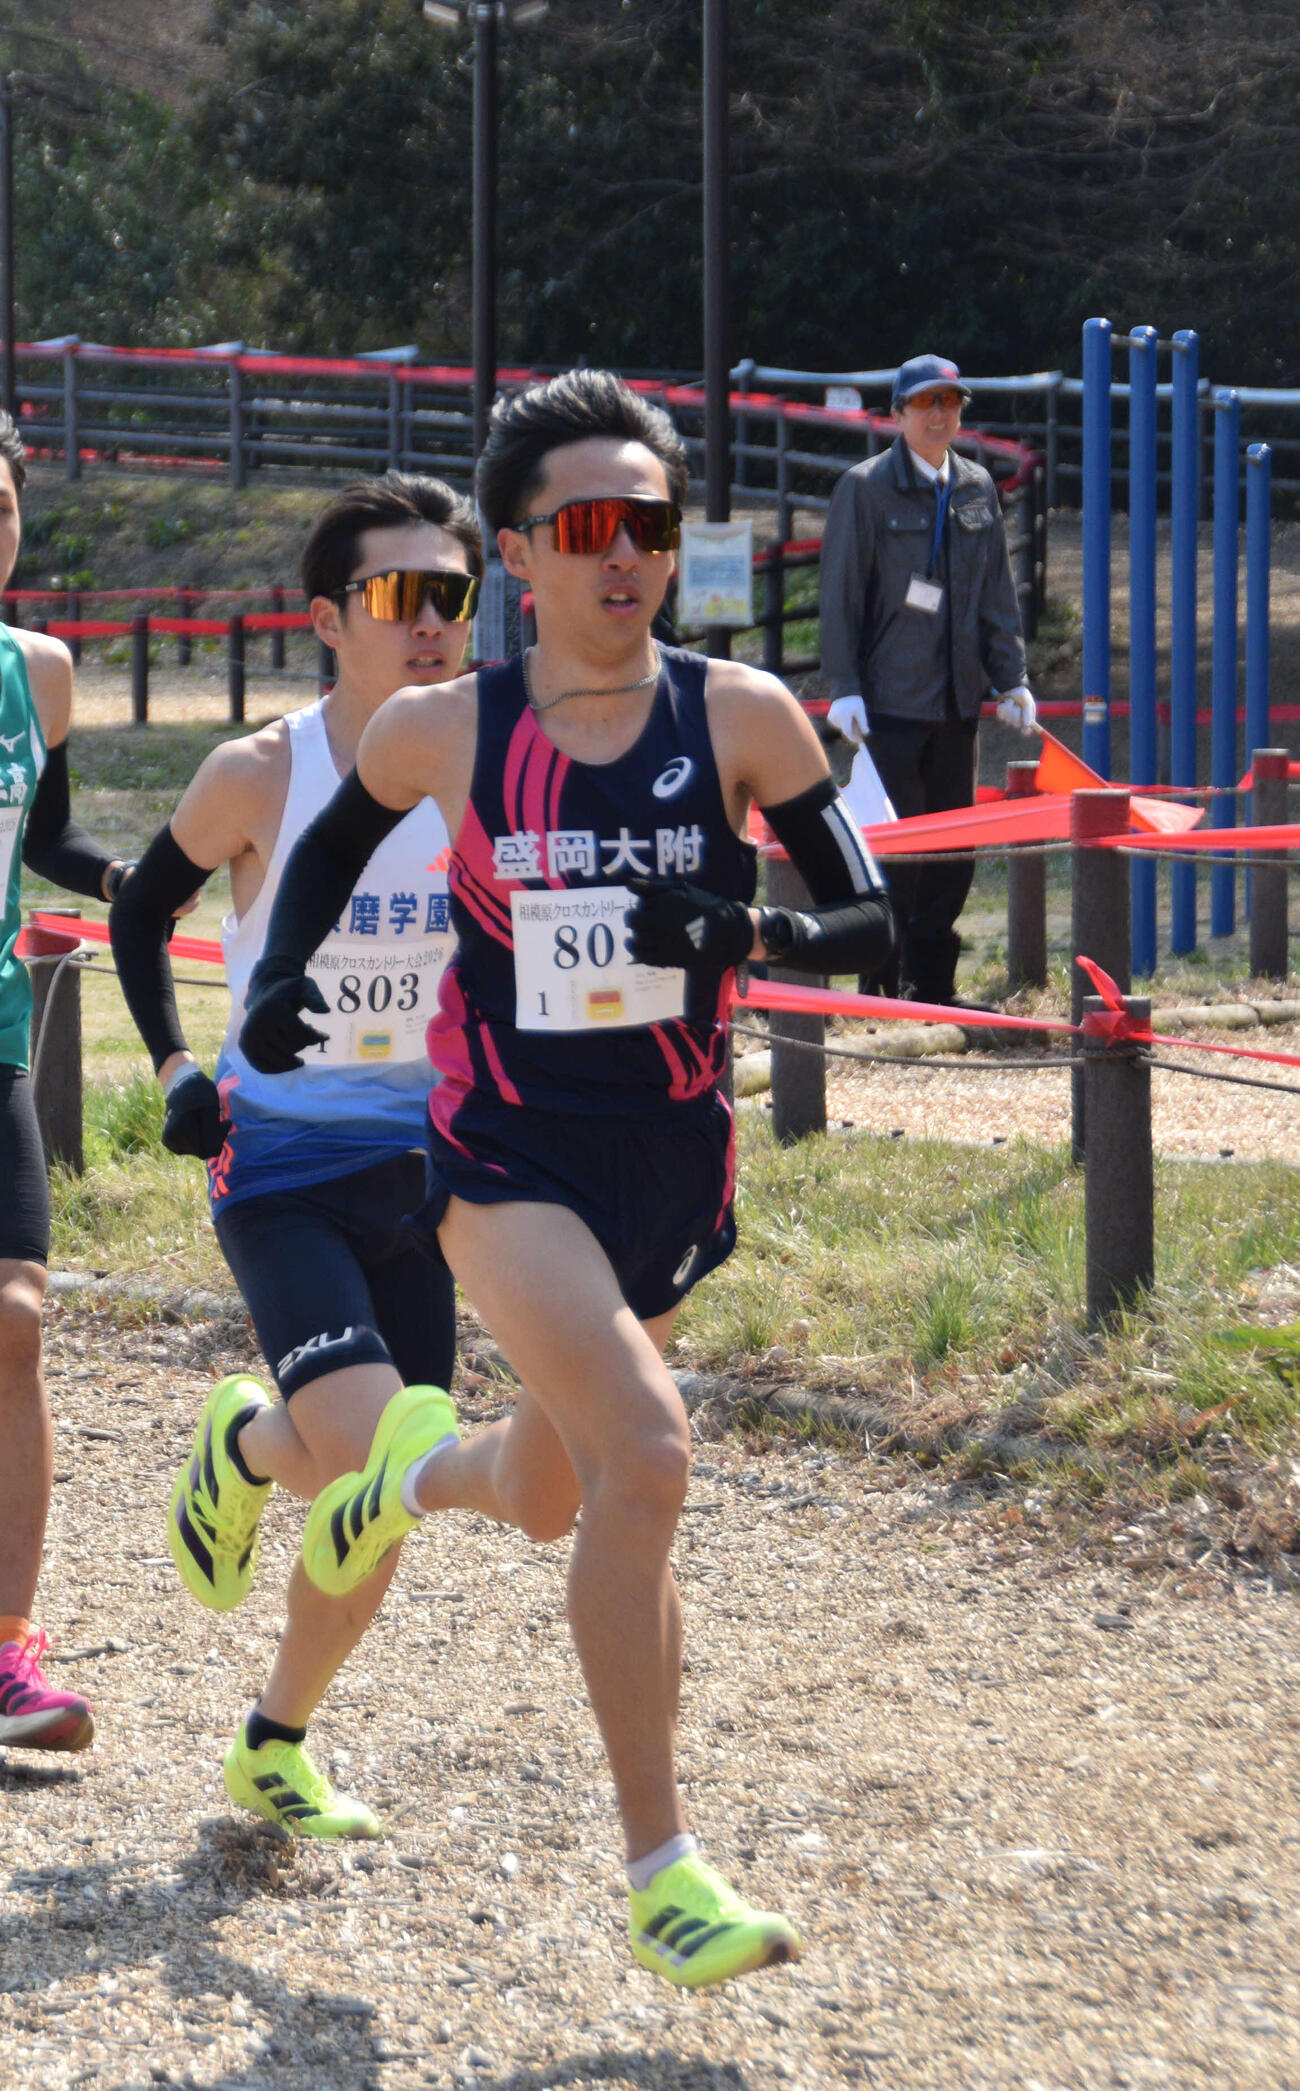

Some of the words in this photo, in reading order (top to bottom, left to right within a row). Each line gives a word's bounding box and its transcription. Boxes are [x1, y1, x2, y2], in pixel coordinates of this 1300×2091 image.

[492, 824, 703, 880] 盛岡大附
[332, 892, 450, 936] 磨学園
[553, 922, 637, 969] 80
[336, 972, 420, 1014] 803
[537, 991, 550, 1016] 1
[276, 1326, 353, 1379] 2XU
